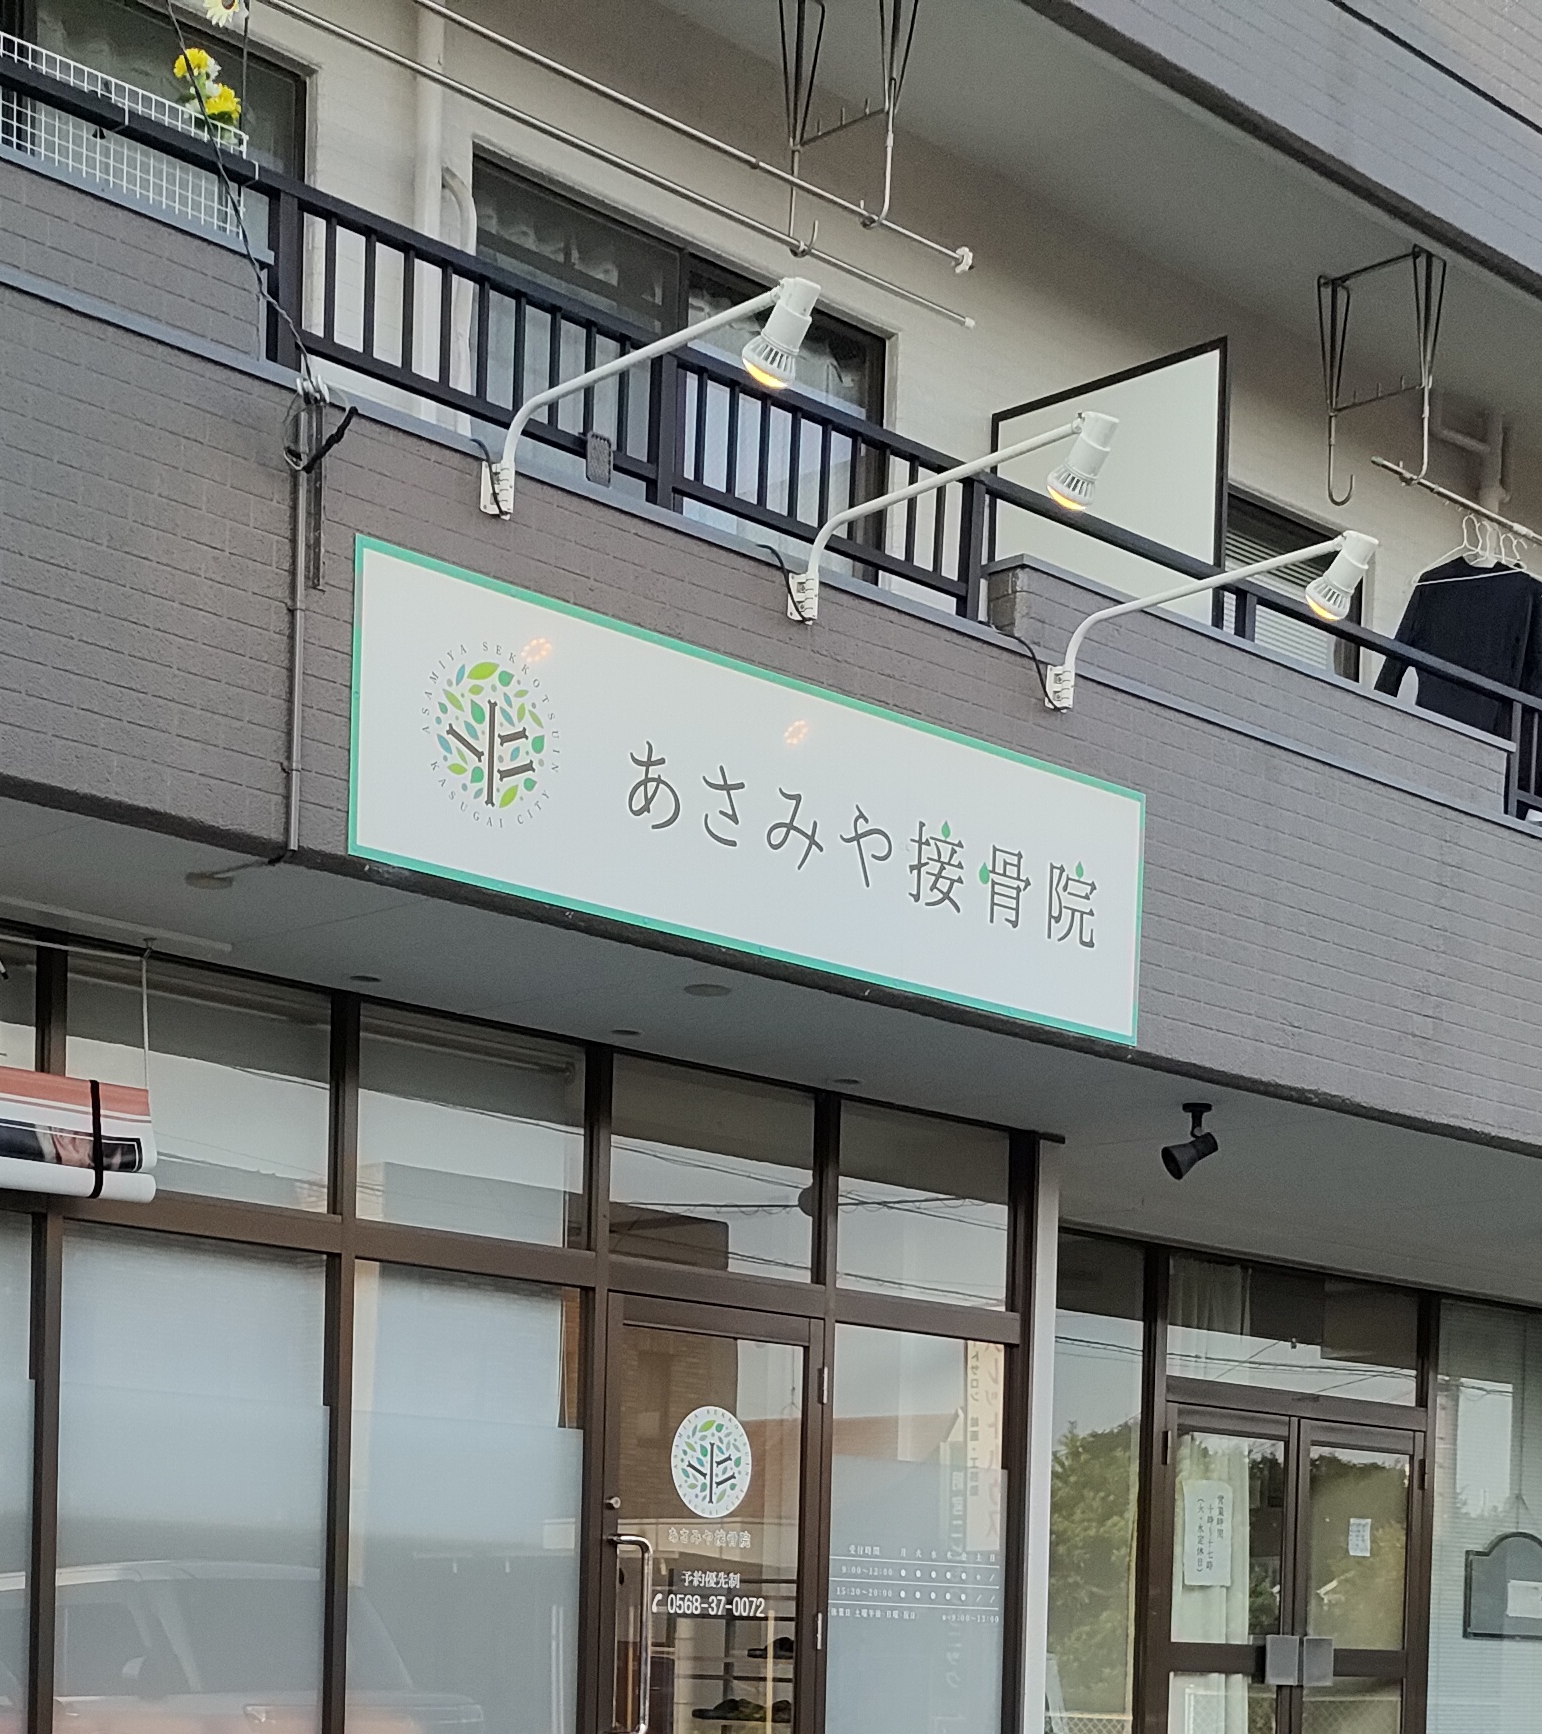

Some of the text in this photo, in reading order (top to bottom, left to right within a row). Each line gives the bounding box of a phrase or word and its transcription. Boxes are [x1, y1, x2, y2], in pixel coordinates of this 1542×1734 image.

[422, 642, 560, 772] ASAMIYA SEKKOTSUIN
[431, 761, 550, 828] KASUGAI CITY
[627, 741, 1098, 949] あさみや接骨院
[668, 1527, 751, 1549] あさみや接骨院
[681, 1570, 741, 1589] 予約優先制
[667, 1593, 766, 1618] 0568-37-0072
